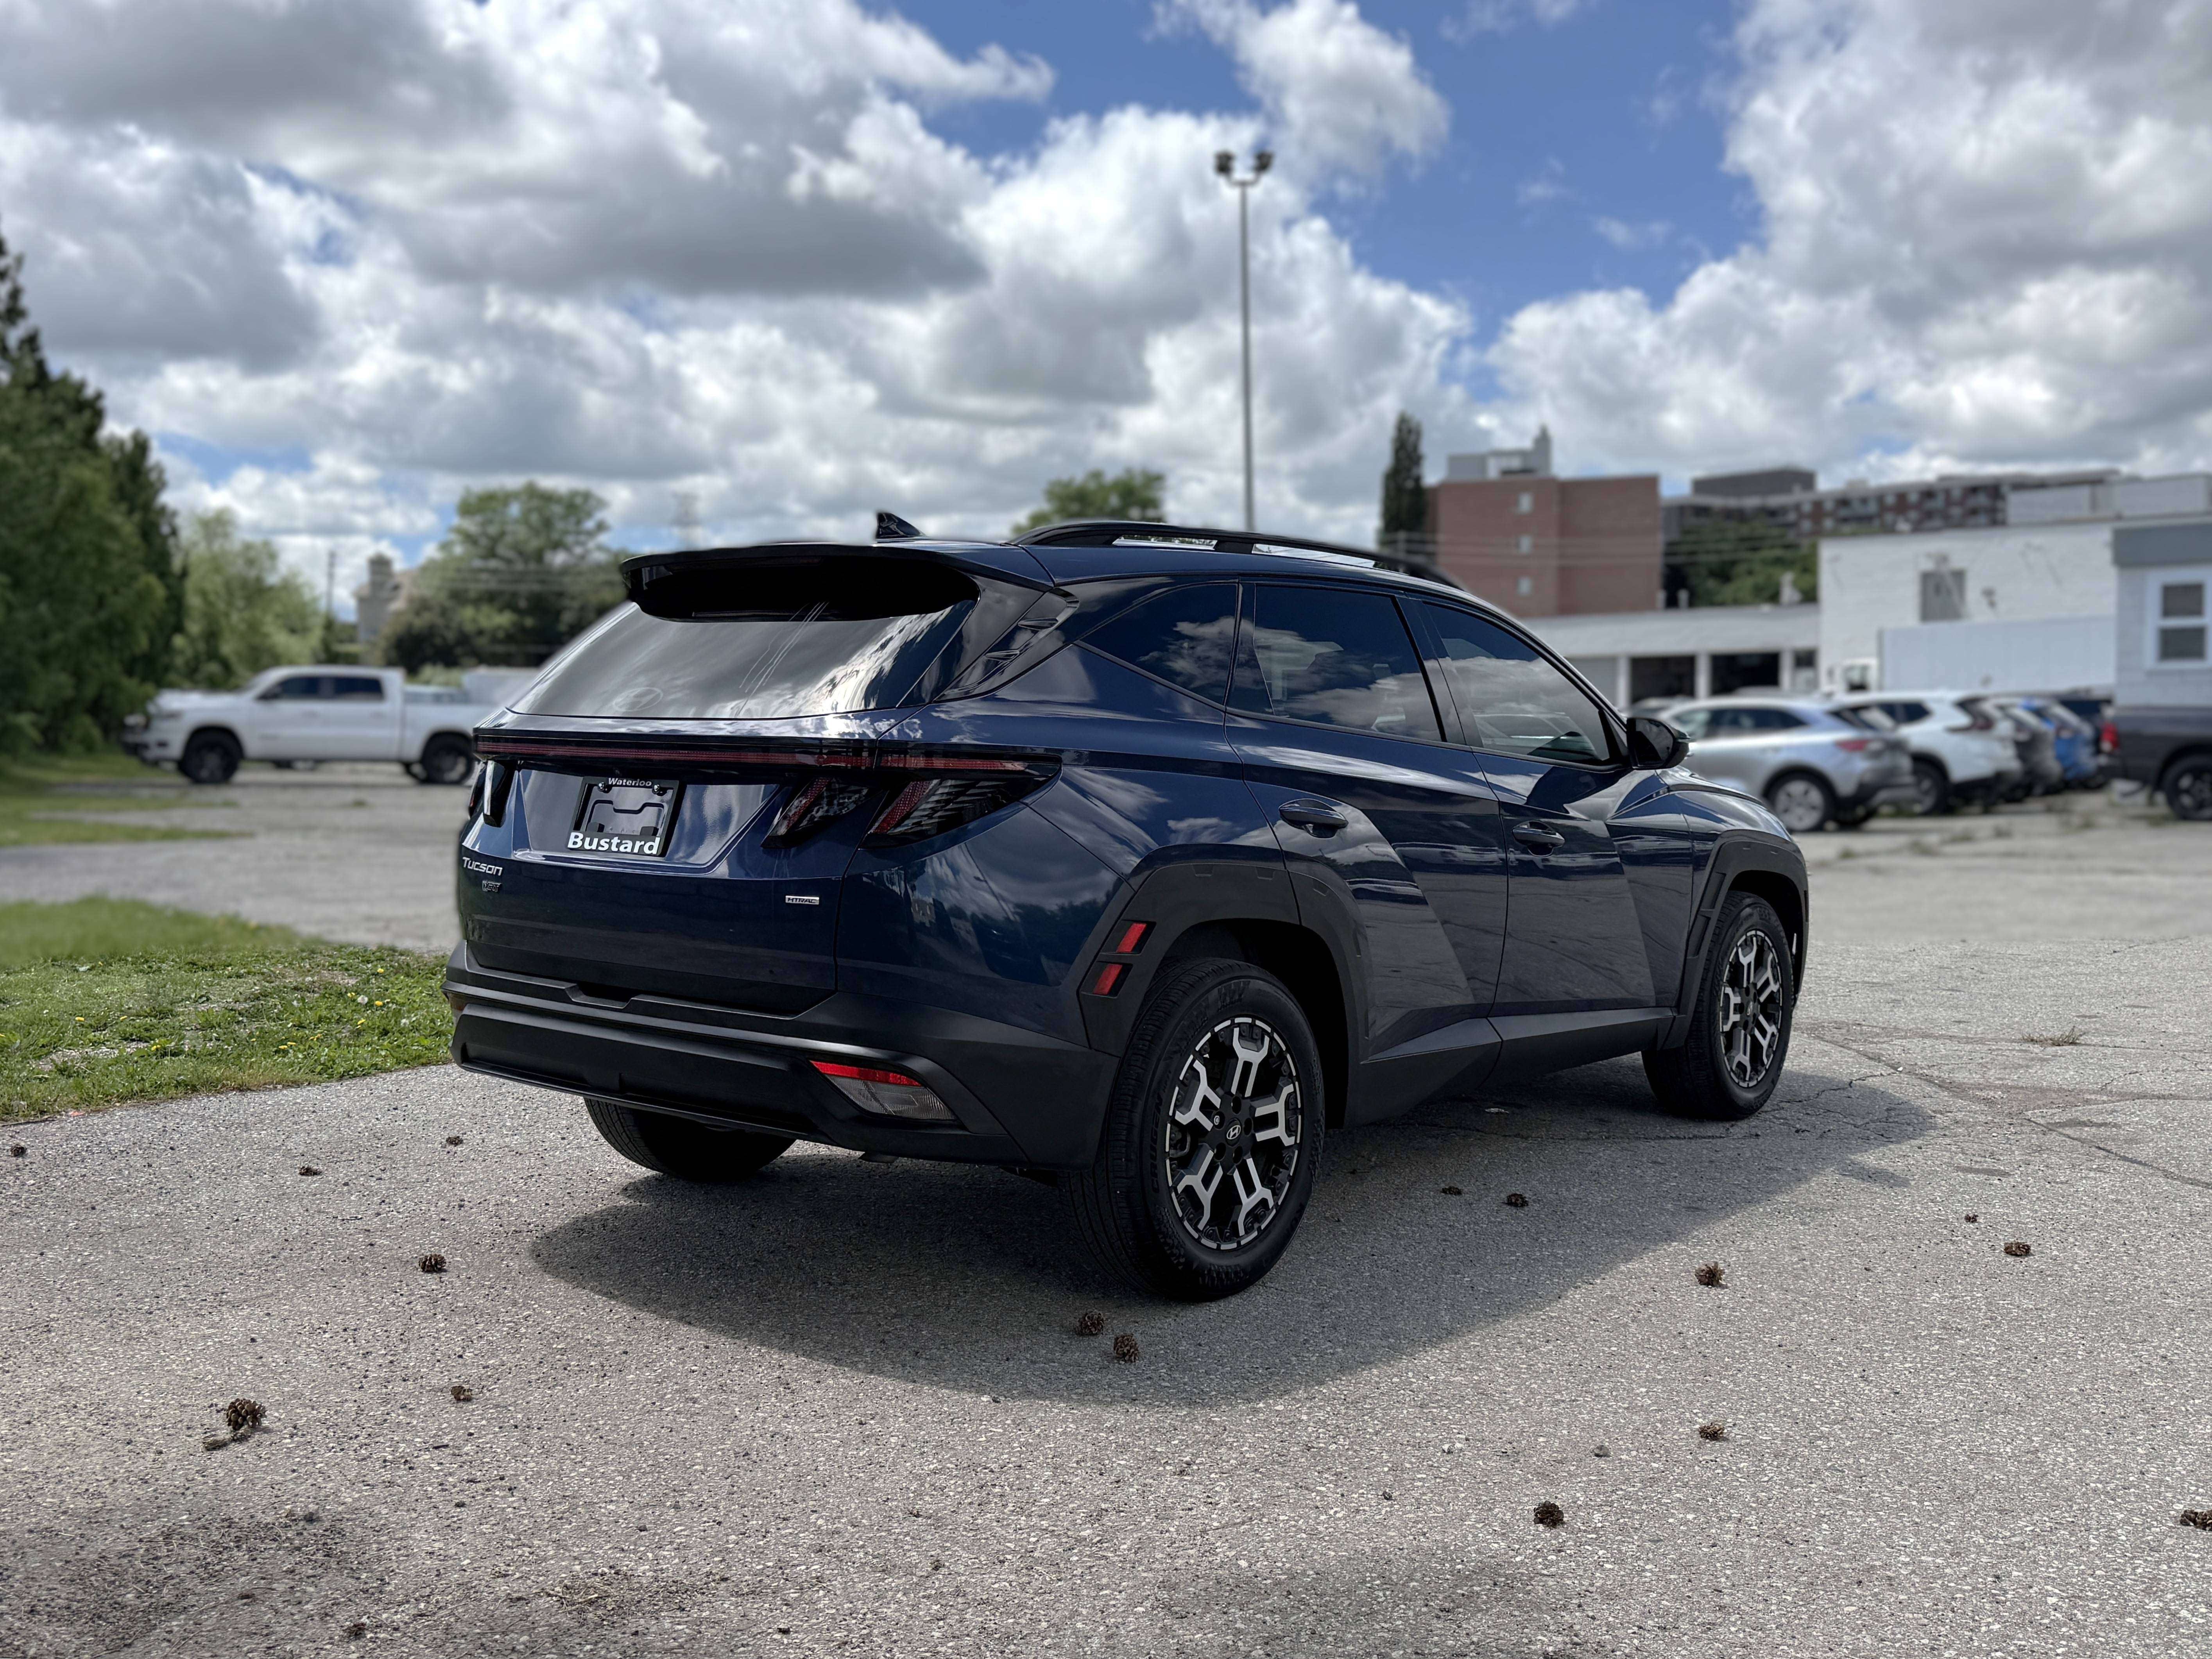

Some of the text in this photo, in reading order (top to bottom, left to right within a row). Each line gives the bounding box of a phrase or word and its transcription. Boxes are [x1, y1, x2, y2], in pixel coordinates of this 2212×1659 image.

[608, 778, 652, 786] Waterloo
[568, 832, 661, 855] Bustard
[1150, 1093, 1163, 1193] CRUGEN
